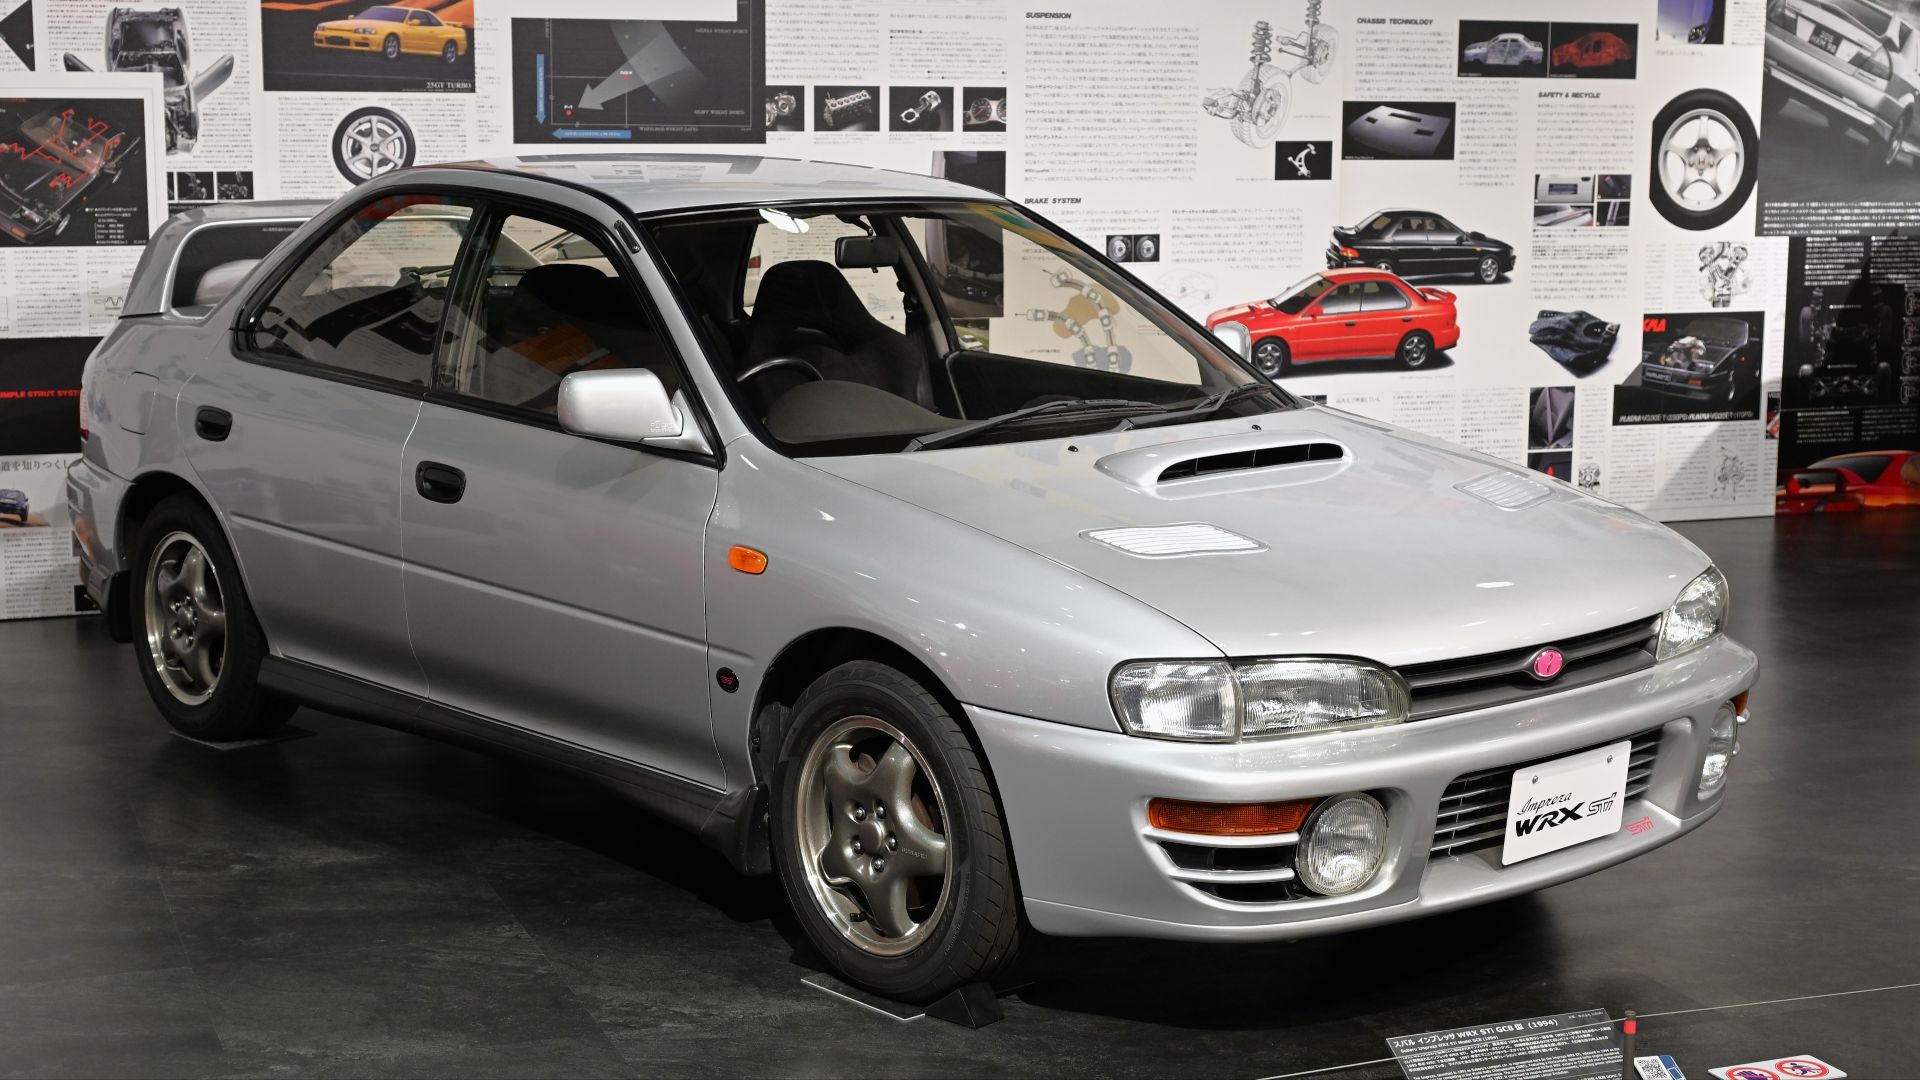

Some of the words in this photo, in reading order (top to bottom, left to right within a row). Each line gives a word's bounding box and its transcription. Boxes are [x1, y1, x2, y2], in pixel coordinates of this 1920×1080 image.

[1517, 792, 1572, 815] Impreza
[1516, 802, 1585, 837] WRX
[1393, 1039, 1415, 1048] スバル
[1417, 1033, 1455, 1044] インプレッサ
[1456, 1030, 1478, 1038] WRX
[1528, 1019, 1558, 1030] (1994)
